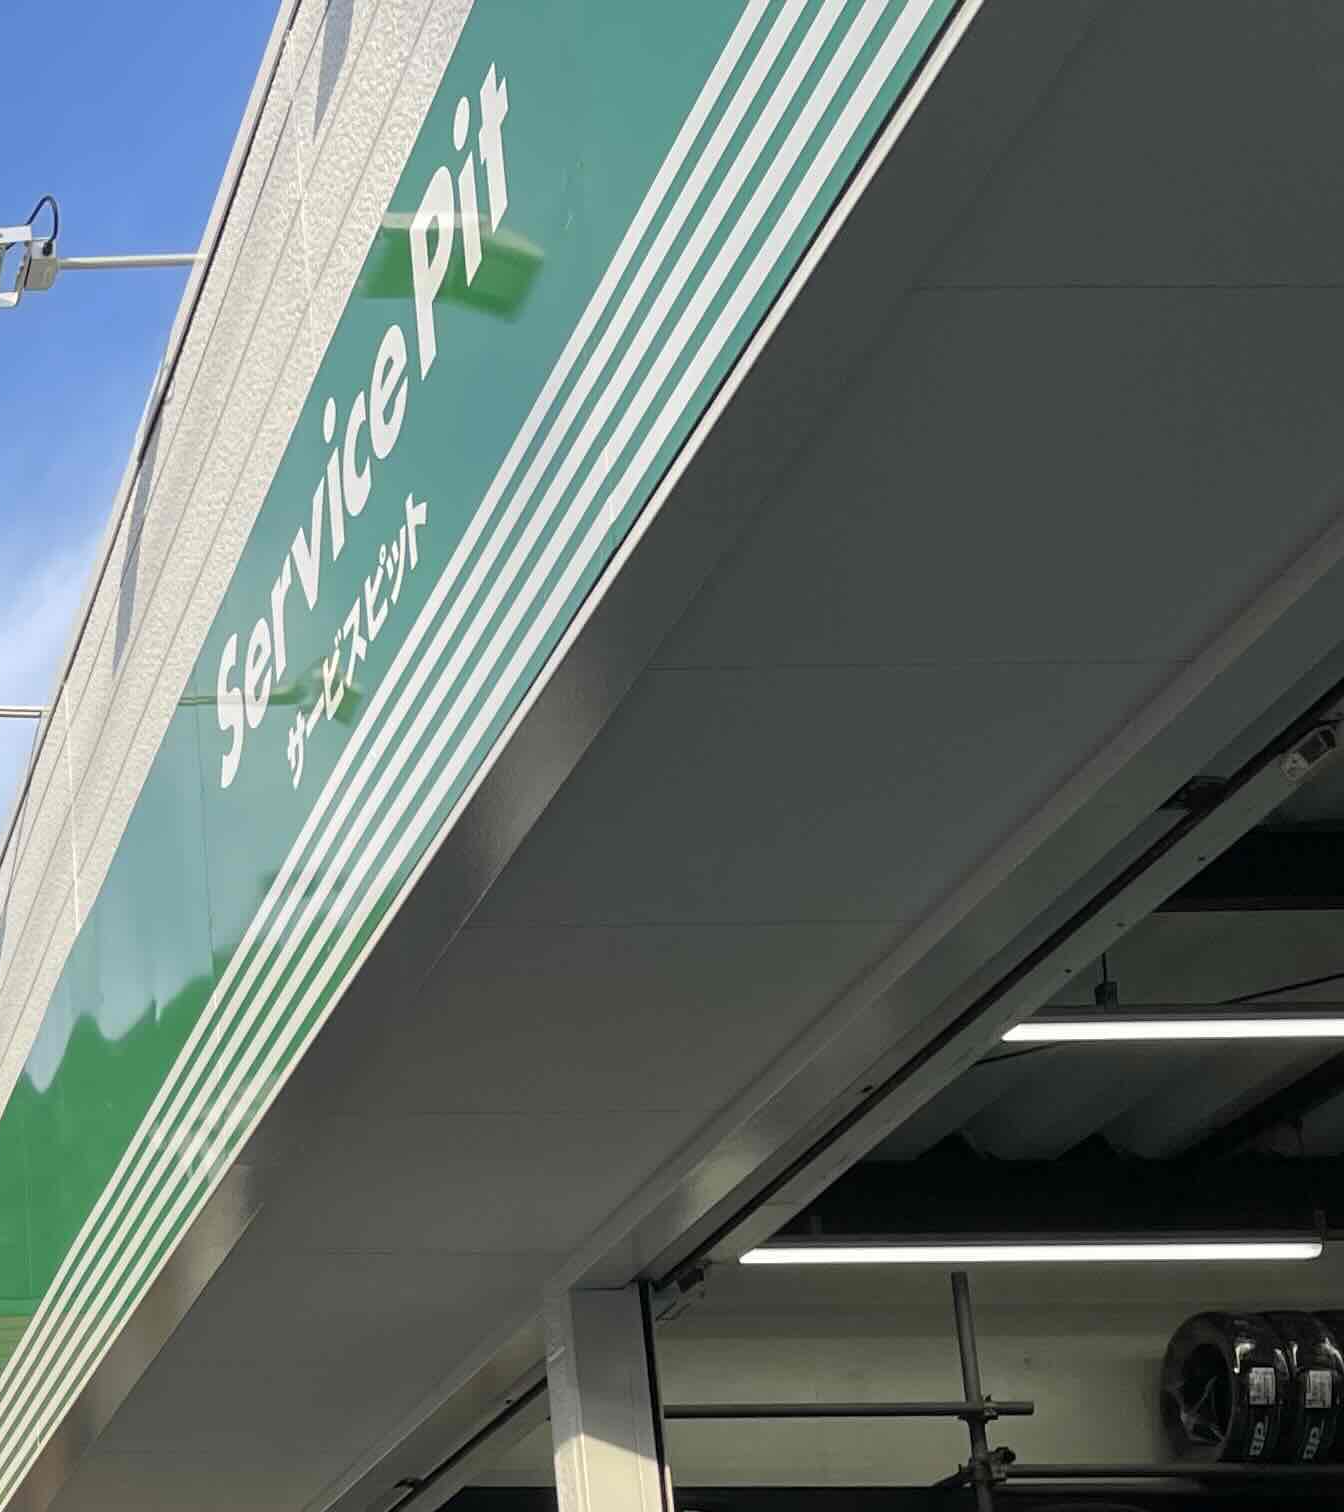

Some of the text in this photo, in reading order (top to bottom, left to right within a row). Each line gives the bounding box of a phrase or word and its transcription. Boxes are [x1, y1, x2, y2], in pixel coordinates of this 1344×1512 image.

[216, 61, 509, 788] Service Pit
[286, 492, 428, 790] サービスピット
